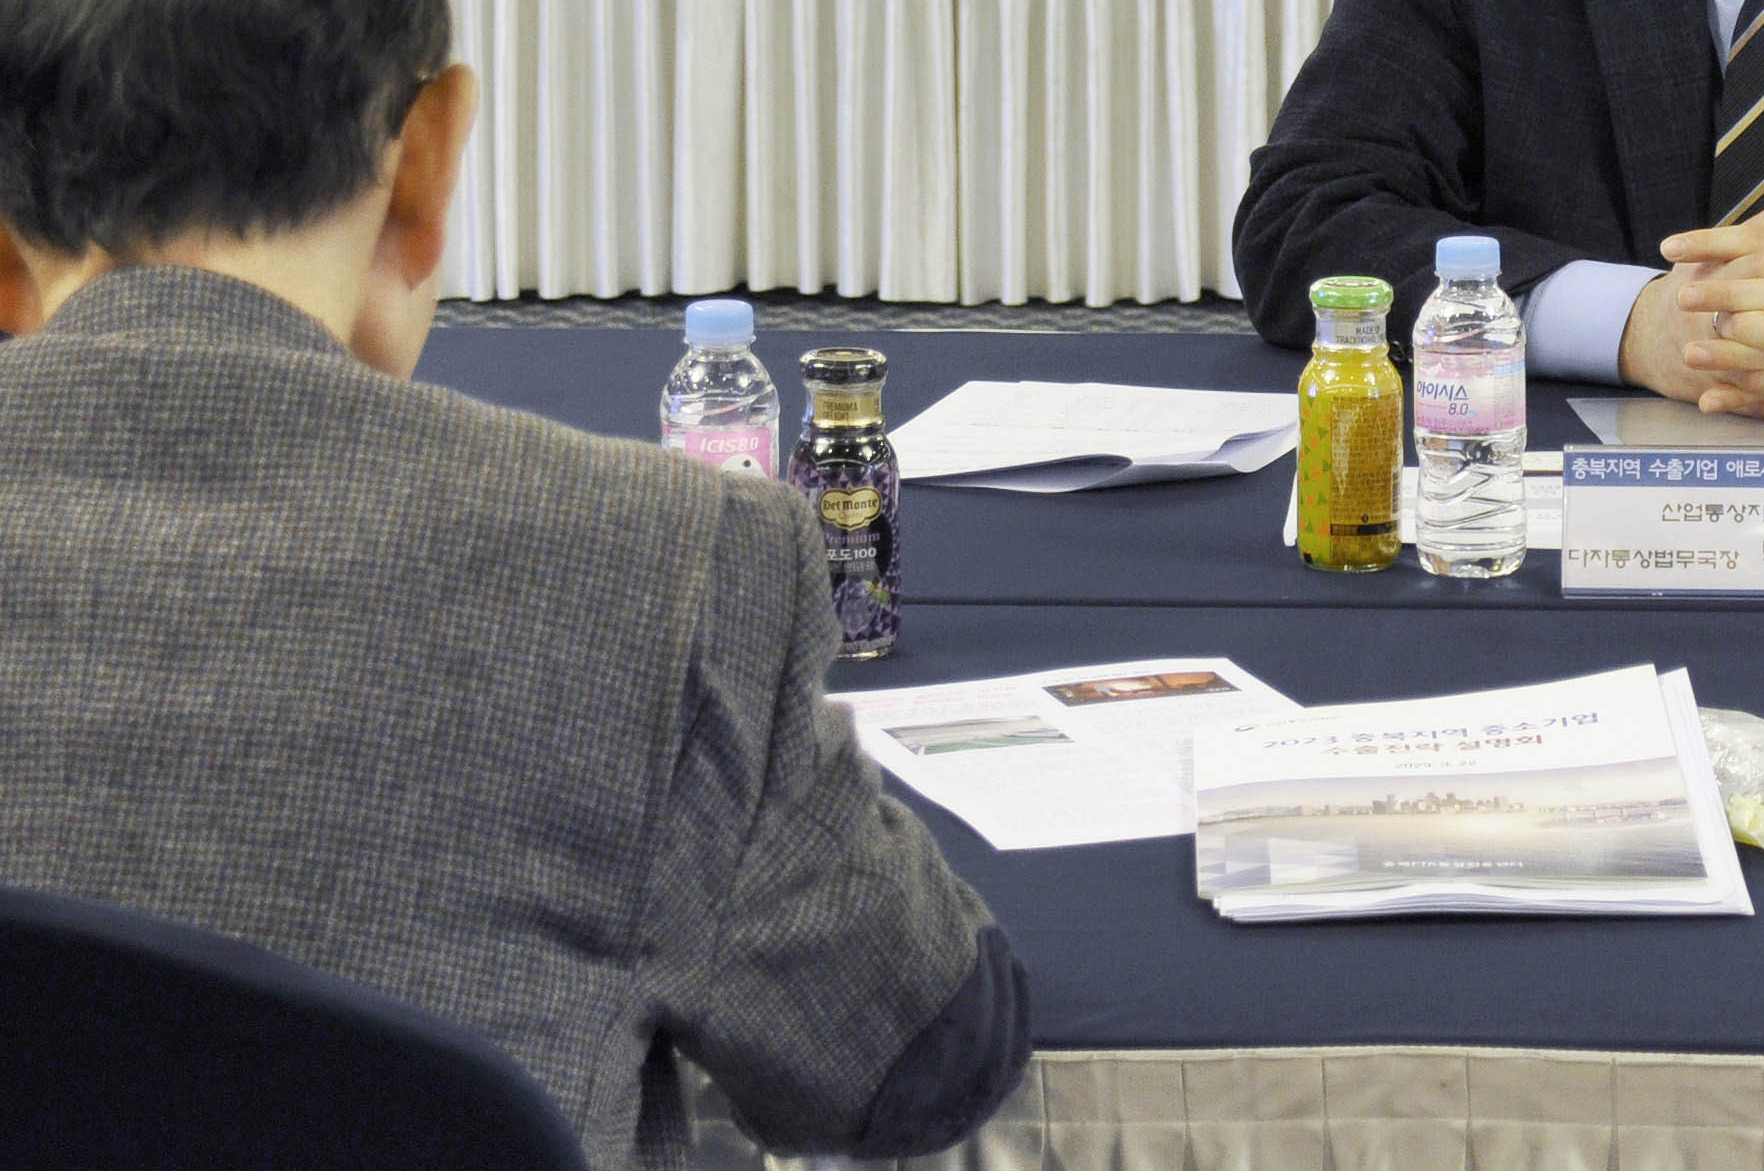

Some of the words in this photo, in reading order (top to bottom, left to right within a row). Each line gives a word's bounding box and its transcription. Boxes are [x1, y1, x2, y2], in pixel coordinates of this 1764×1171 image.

[1448, 403, 1469, 416] 8.0
[1571, 458, 1641, 480] 충북지역
[1648, 458, 1719, 481] 수출기업
[1568, 549, 1739, 570] 다자통상법무국장
